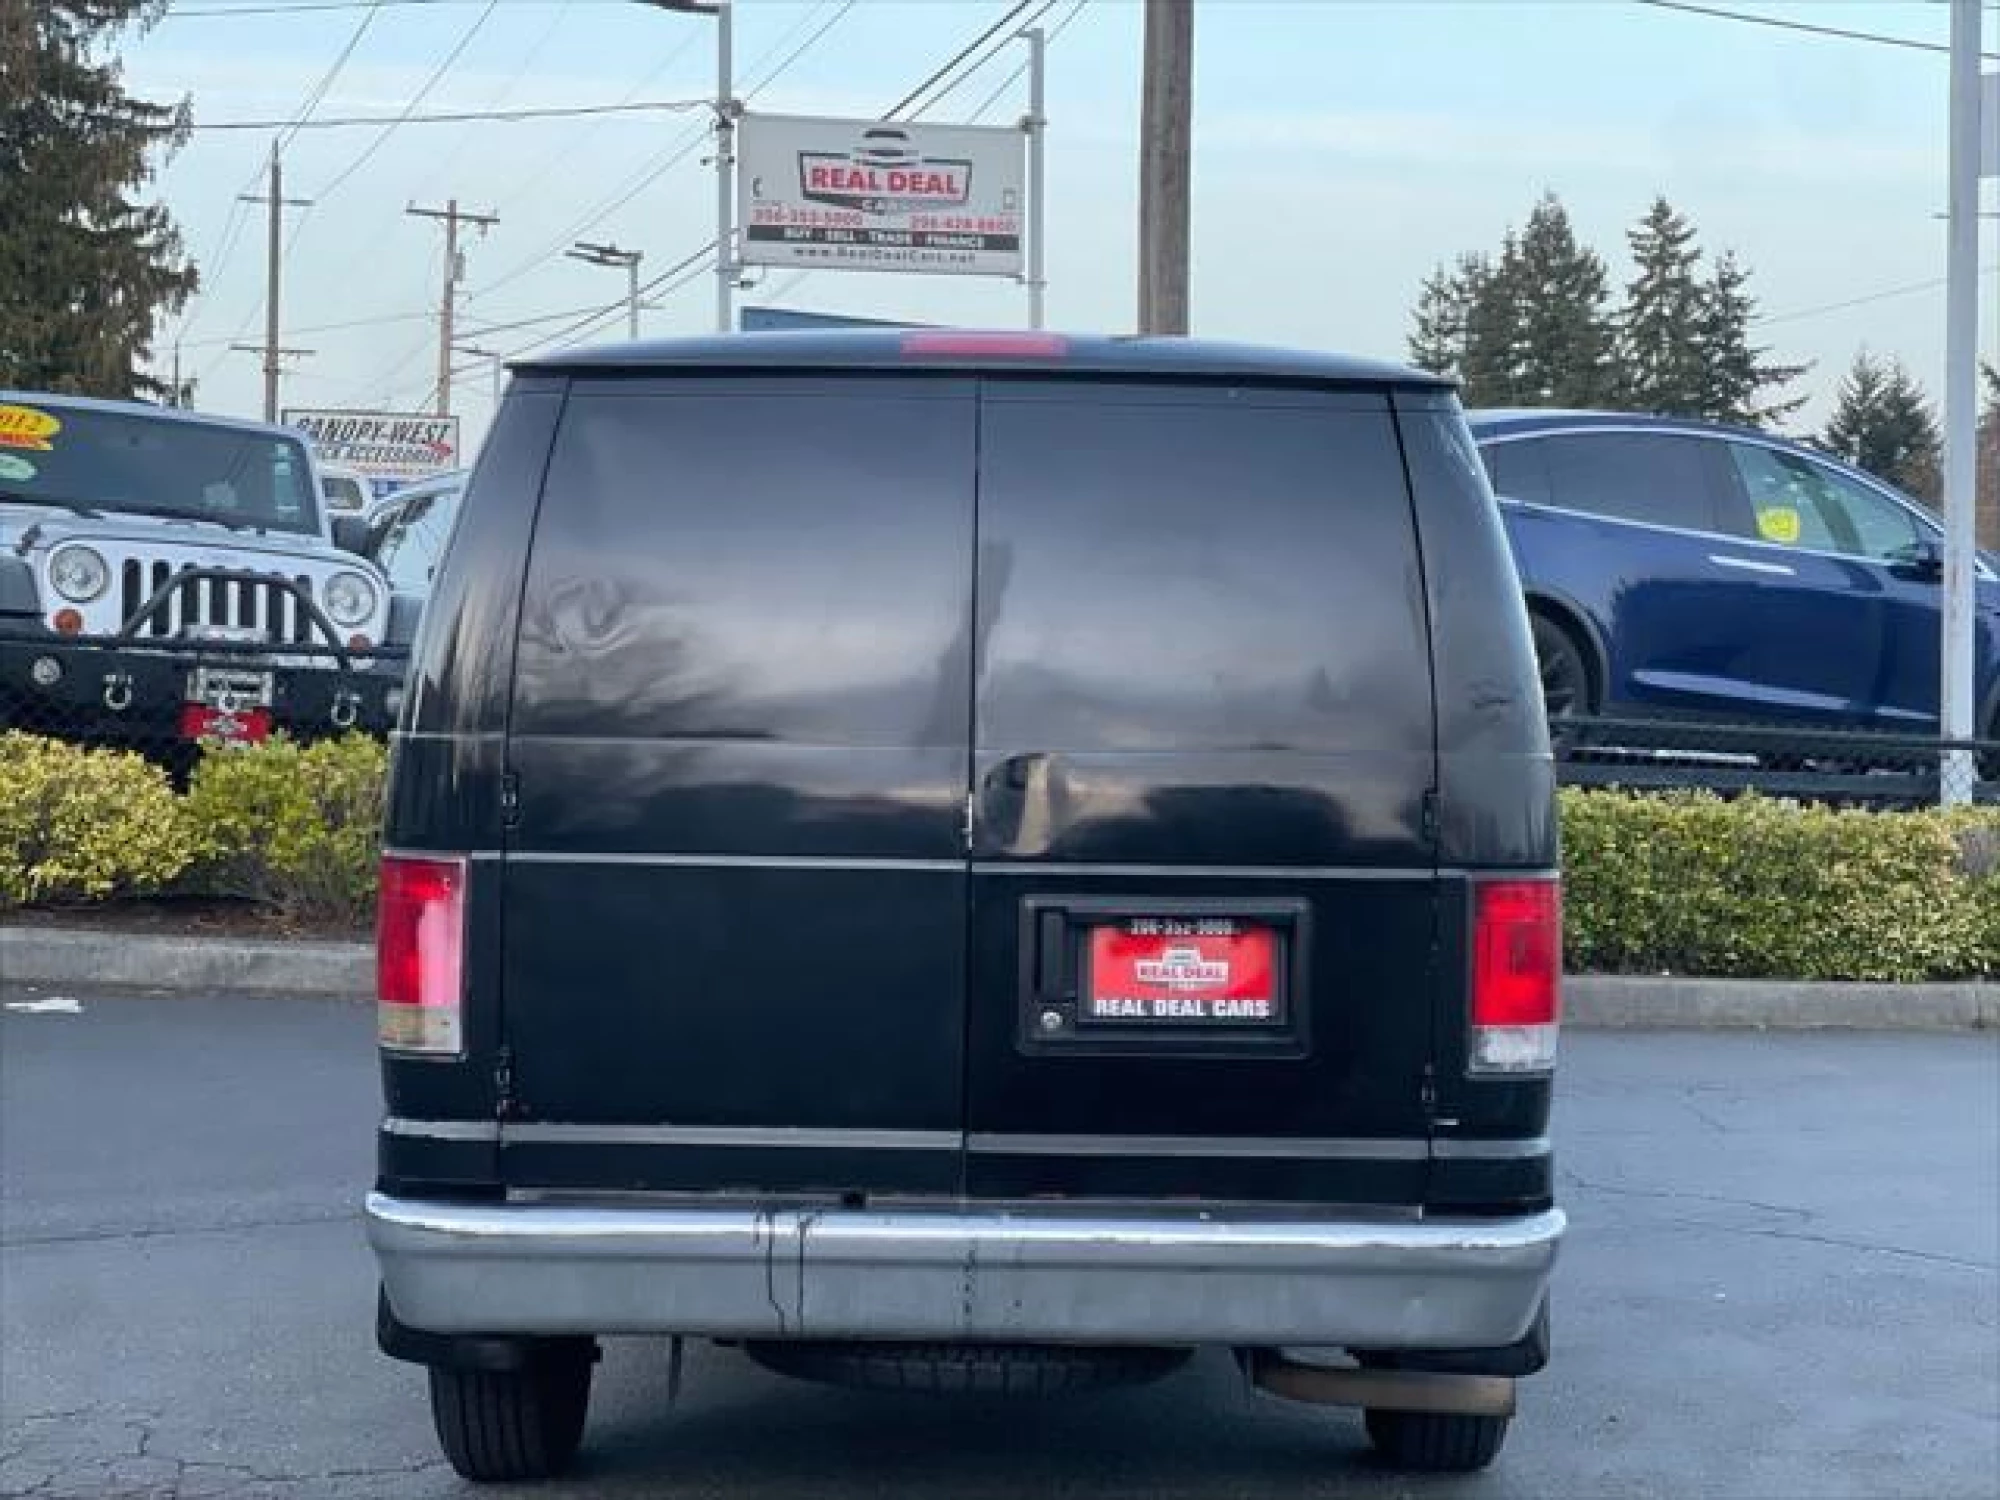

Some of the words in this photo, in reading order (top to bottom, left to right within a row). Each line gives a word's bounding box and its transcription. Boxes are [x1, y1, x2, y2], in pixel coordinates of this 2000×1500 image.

[811, 166, 883, 192] REAL
[887, 171, 960, 195] DEAL
[783, 227, 812, 240] BUY
[825, 229, 855, 242] SELL
[868, 231, 912, 244] TRADE
[925, 234, 985, 249] FINANCE
[1094, 998, 1148, 1017] REAL
[1153, 998, 1206, 1017] DEAL
[1212, 998, 1270, 1018] CARS
